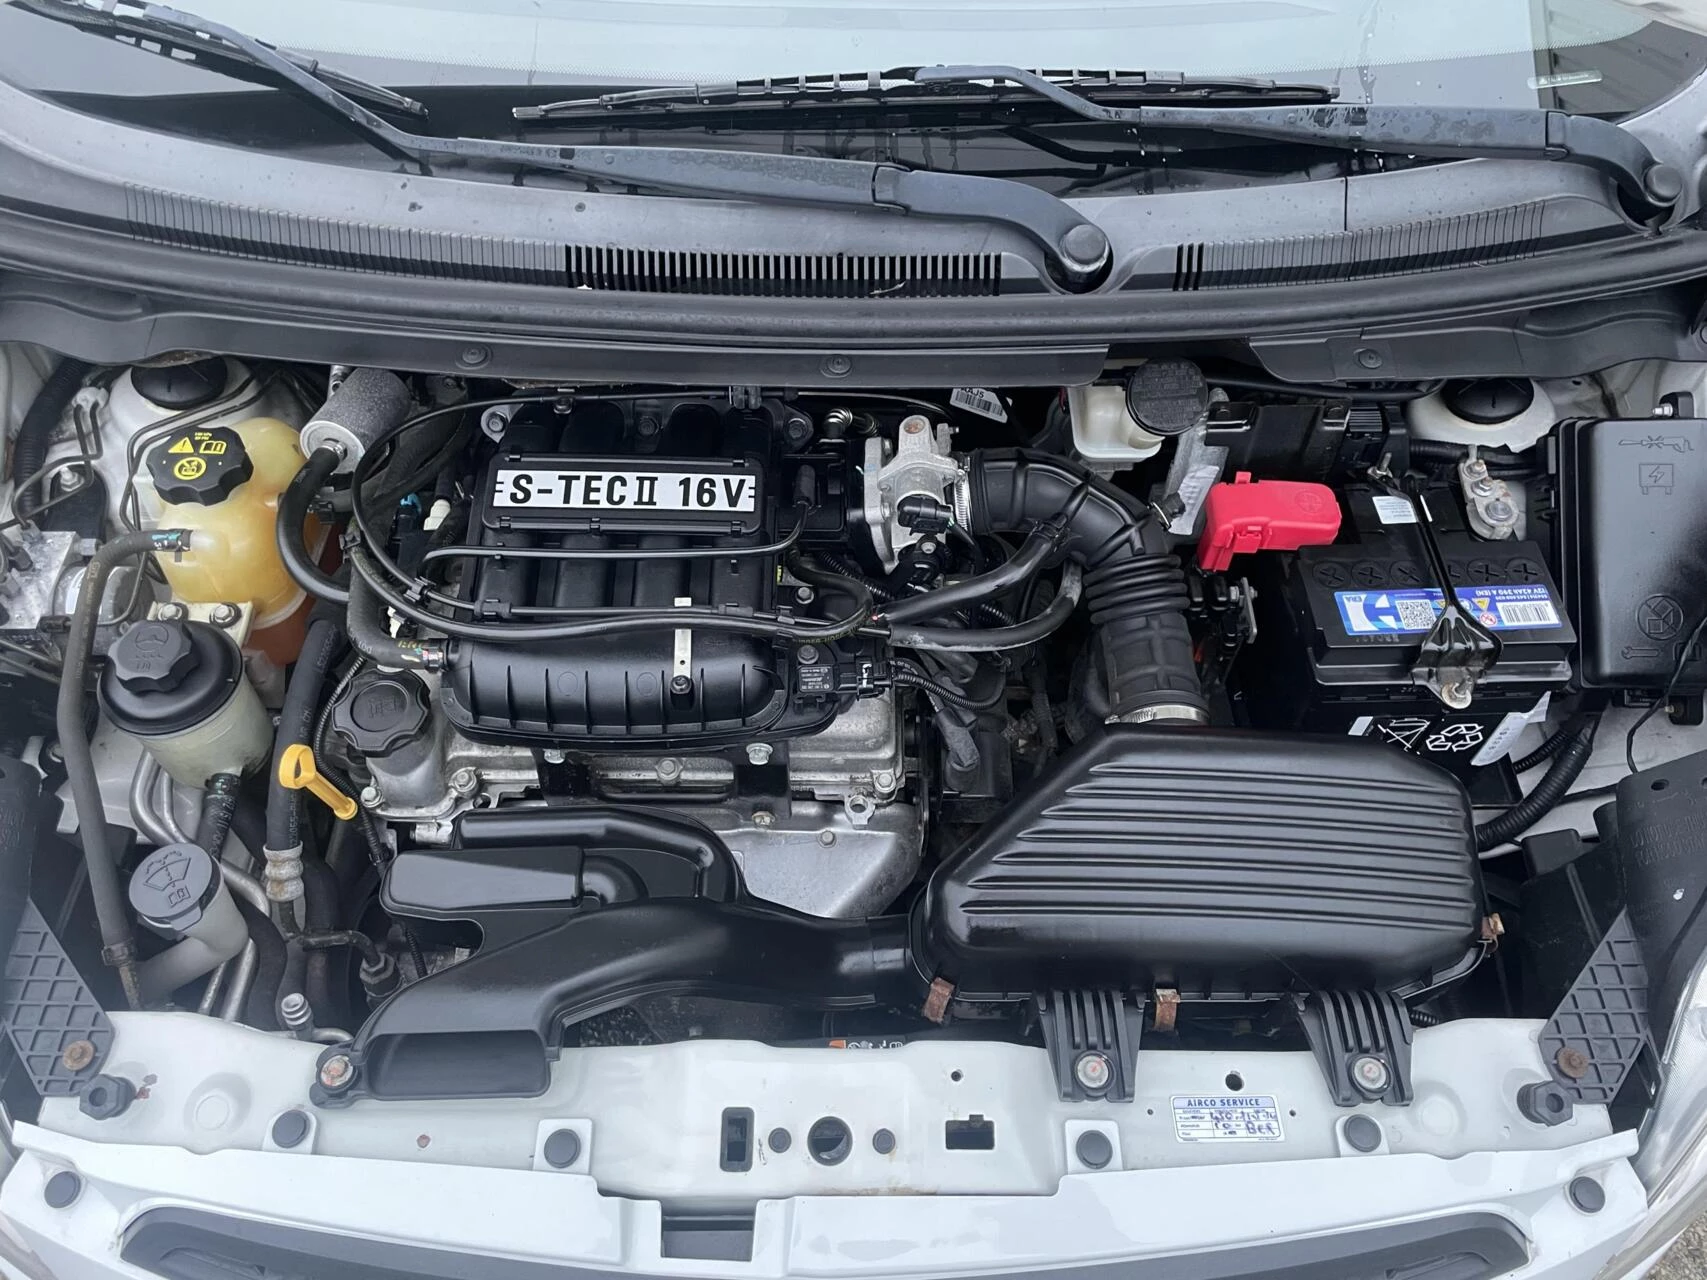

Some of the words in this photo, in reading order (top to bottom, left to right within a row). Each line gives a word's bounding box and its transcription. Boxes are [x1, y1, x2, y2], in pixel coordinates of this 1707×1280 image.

[678, 476, 746, 508] 16V
[1187, 1098, 1217, 1107] AIRCO
[1220, 1098, 1260, 1107] SERVICE
